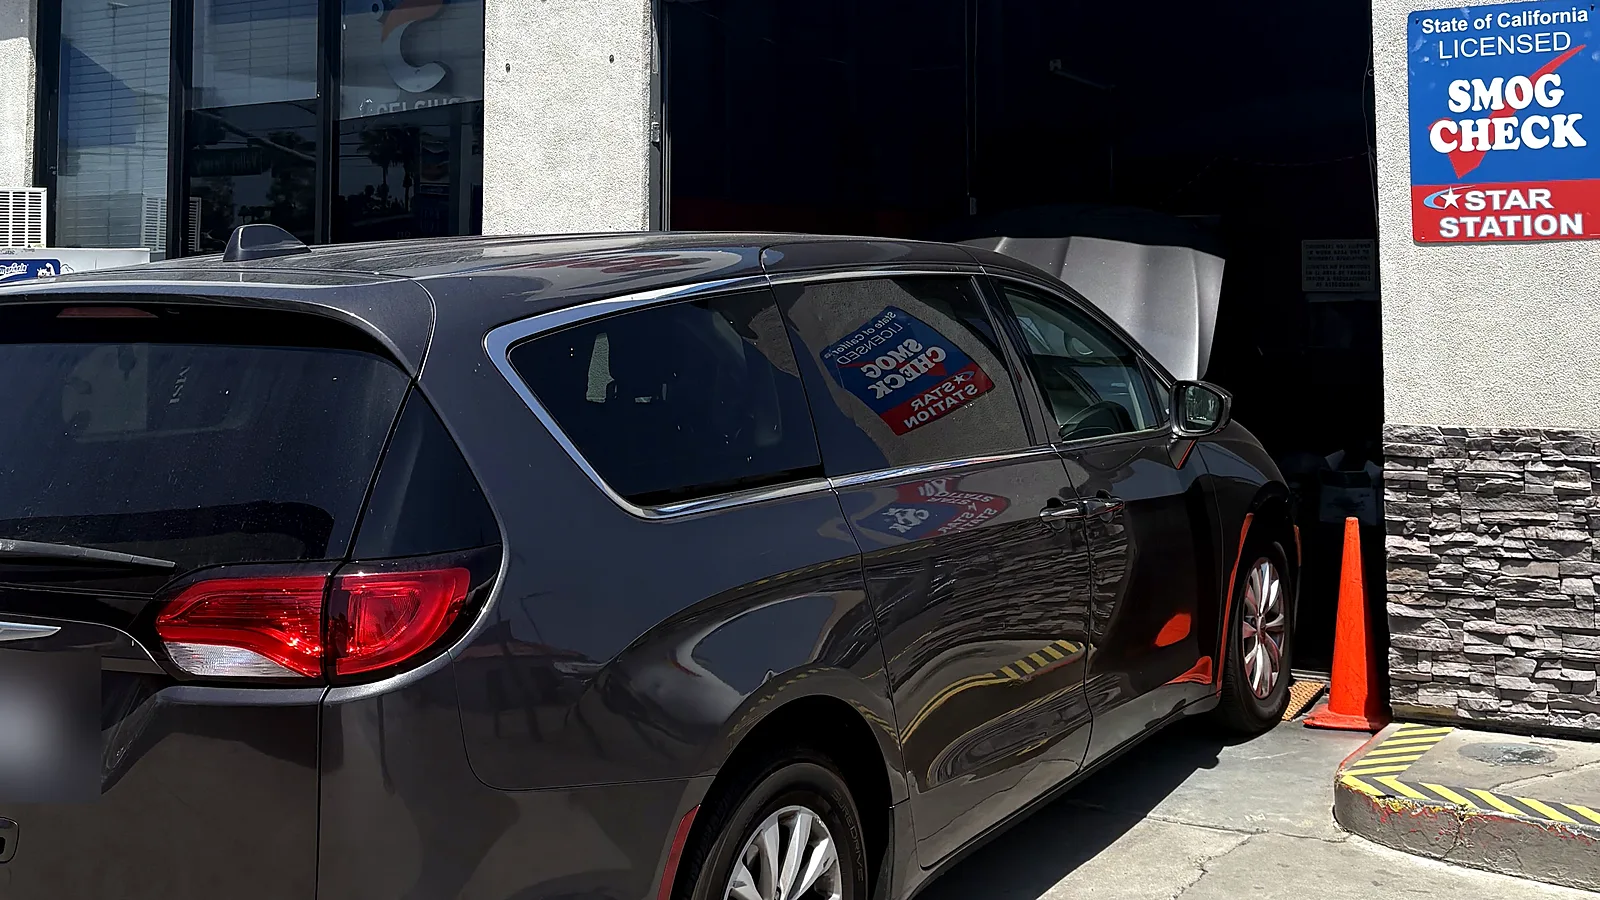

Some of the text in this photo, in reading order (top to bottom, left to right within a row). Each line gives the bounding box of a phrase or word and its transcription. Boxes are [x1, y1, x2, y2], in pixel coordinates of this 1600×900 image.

[1421, 7, 1588, 34] State of California
[1439, 31, 1571, 60] LICENSED
[1448, 73, 1565, 113] SMOG
[1429, 113, 1587, 154] CHECK
[1464, 188, 1554, 212] STAR
[1439, 213, 1583, 238] STATION
